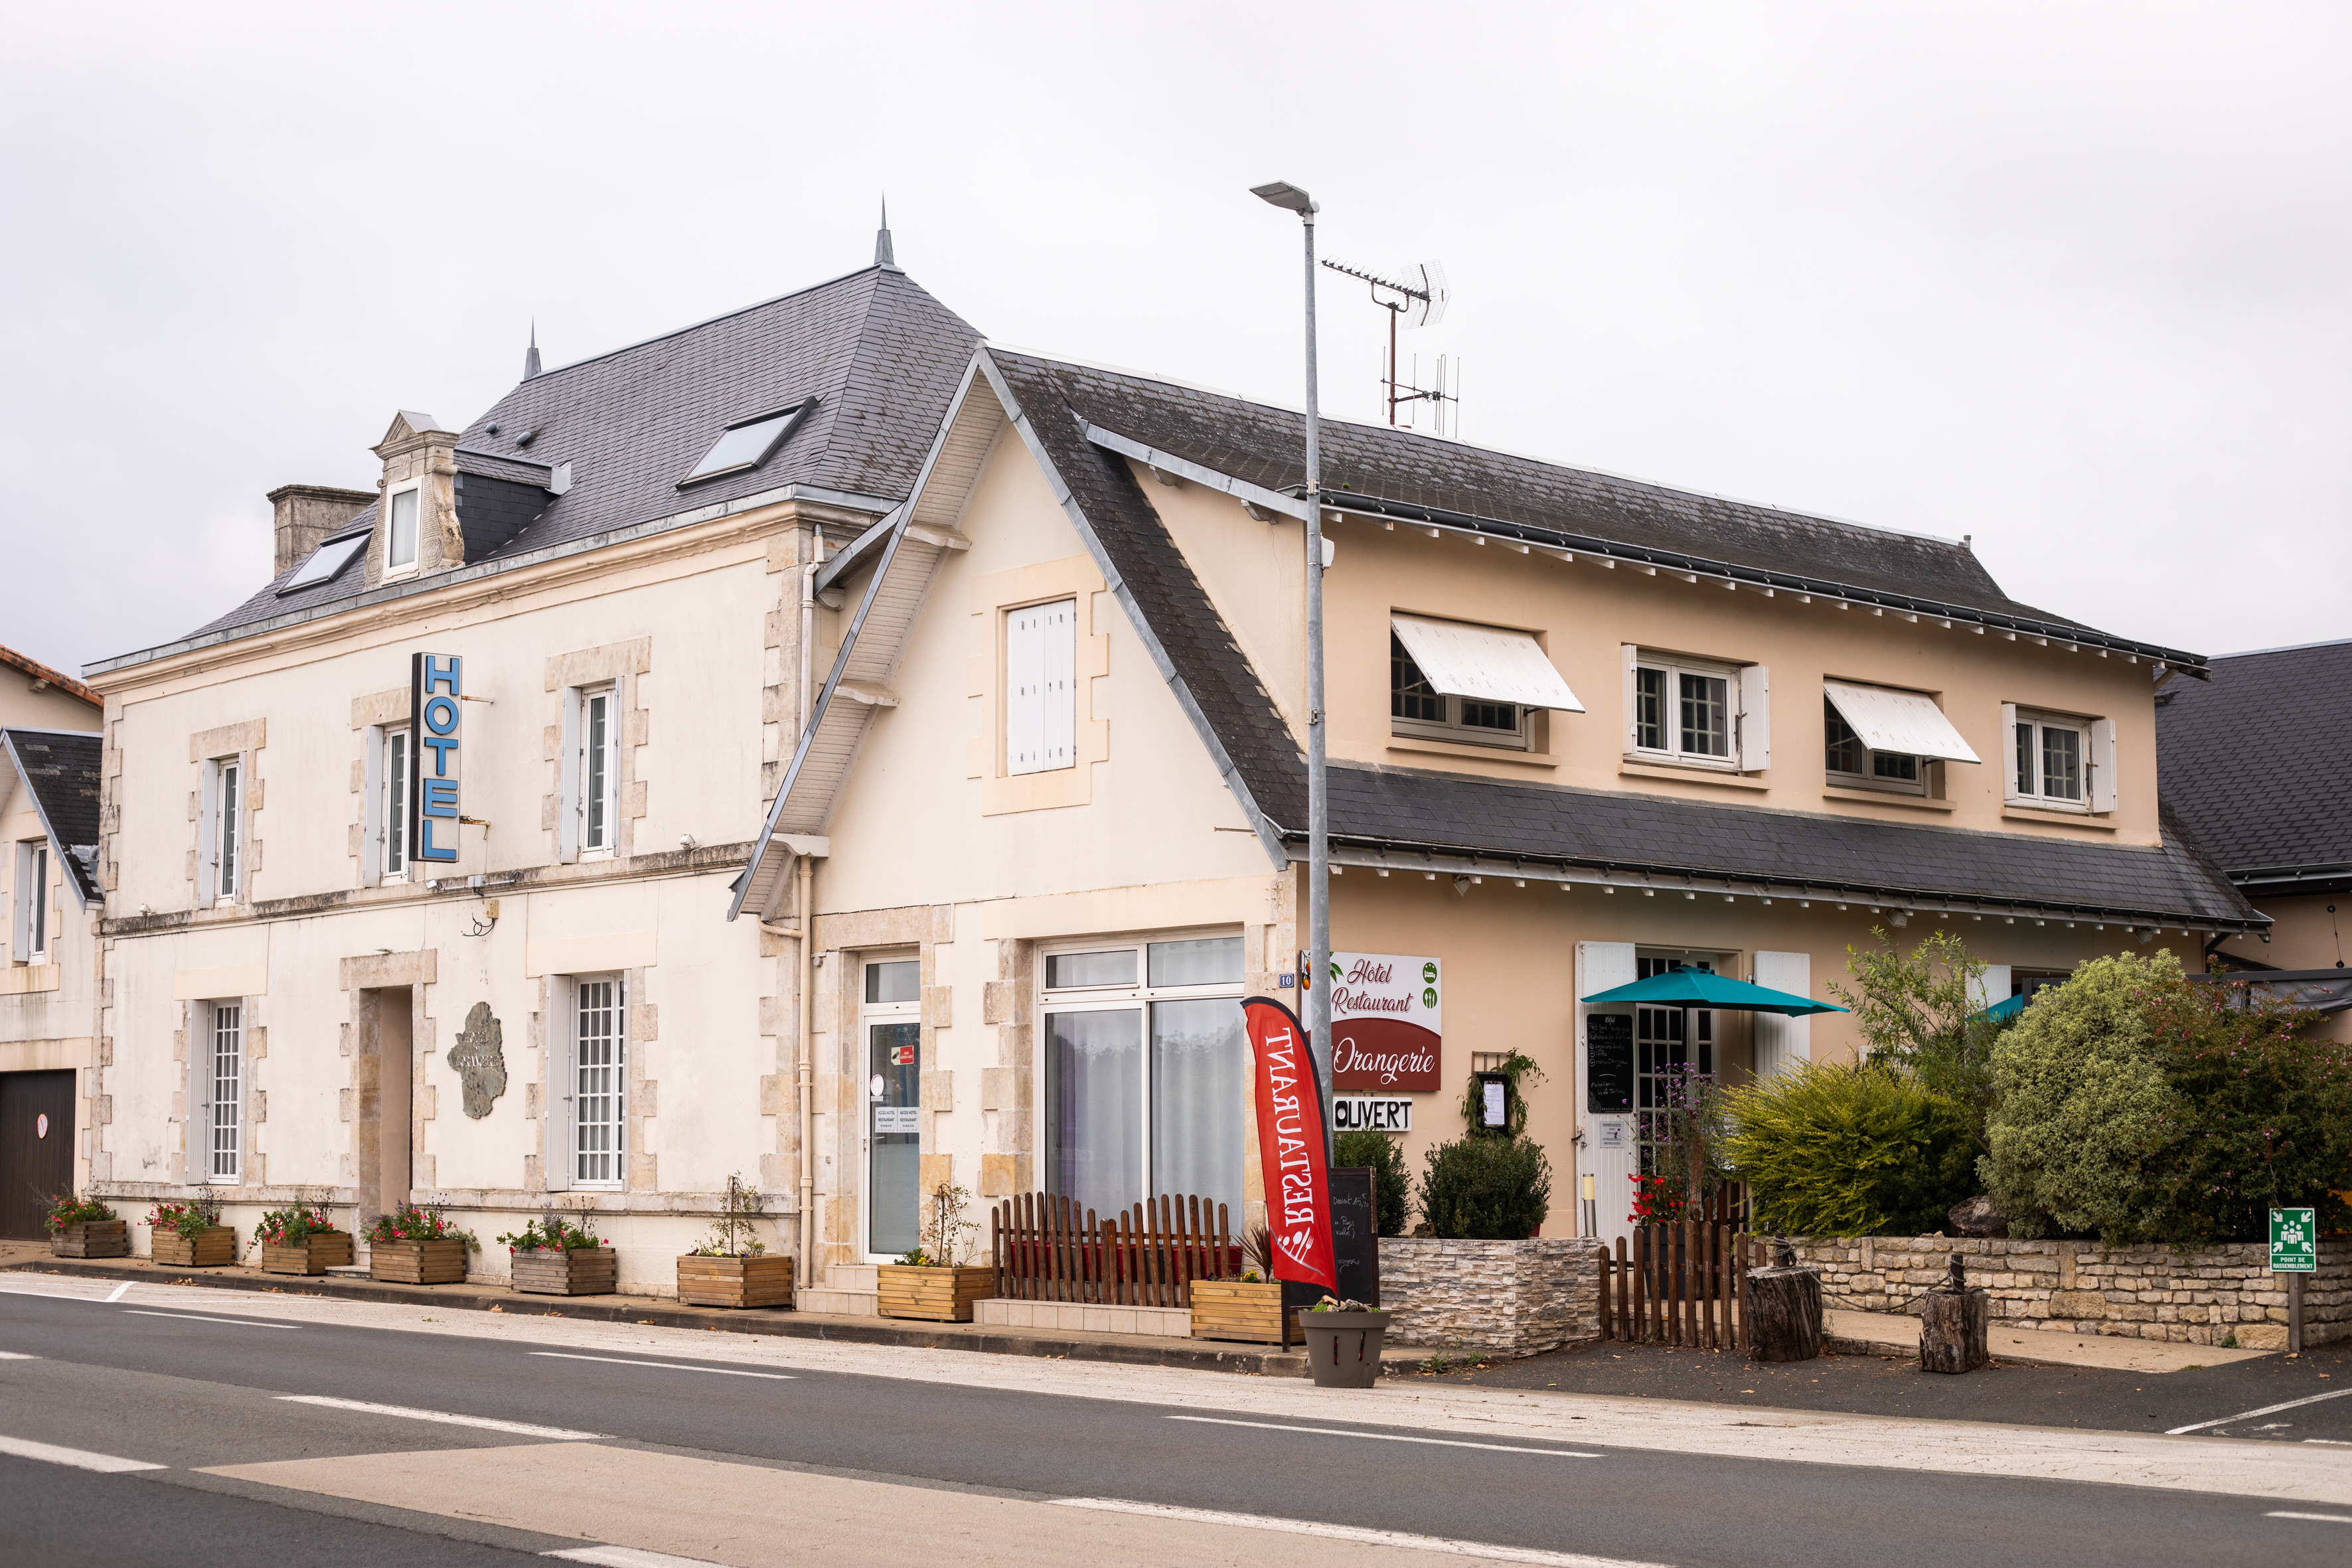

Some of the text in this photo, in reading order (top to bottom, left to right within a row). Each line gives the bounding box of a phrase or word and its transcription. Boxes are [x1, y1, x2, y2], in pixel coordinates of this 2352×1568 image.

[423, 655, 459, 858] HOTEL
[1281, 977, 1291, 986] 10
[1346, 959, 1393, 985] Hôtel
[1330, 986, 1413, 1016] Restaurant
[465, 1032, 489, 1043] HOTEL
[1331, 1037, 1435, 1085] 'Orangerie
[1336, 1101, 1412, 1128] OUVERT
